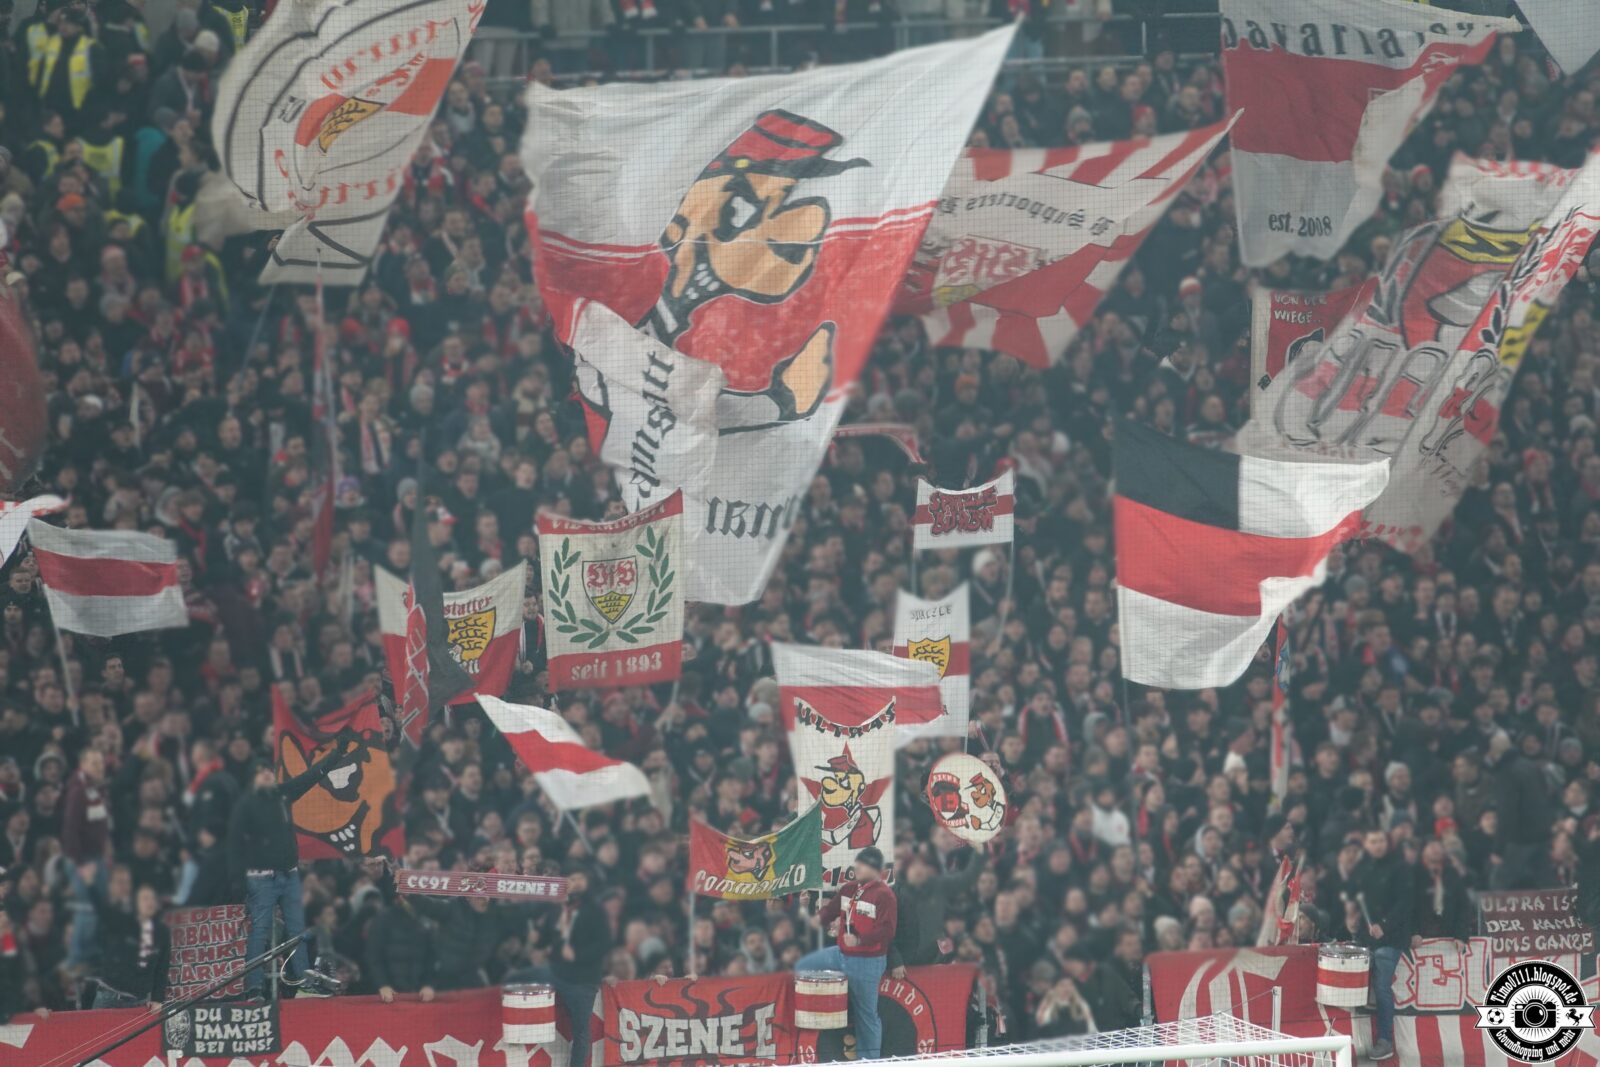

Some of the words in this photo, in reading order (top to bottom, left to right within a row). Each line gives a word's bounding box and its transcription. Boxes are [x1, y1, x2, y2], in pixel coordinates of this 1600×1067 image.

[1268, 211, 1294, 234] est.
[1299, 215, 1332, 236] 2008
[571, 658, 607, 681] seit
[615, 652, 662, 677] 1893
[407, 875, 450, 891] CC97
[497, 880, 546, 896] SZENE
[1480, 896, 1546, 913] ULTRA
[1486, 919, 1525, 933] DER
[1492, 936, 1531, 953] UMS
[1535, 932, 1593, 952] GANZE
[195, 1008, 222, 1022] DU
[231, 1005, 272, 1022] BIST
[195, 1021, 273, 1040] IMMER
[619, 1007, 745, 1062] SZENE
[753, 1002, 777, 1061] E
[195, 1040, 224, 1053] BEI
[232, 1037, 275, 1053] UNS!
